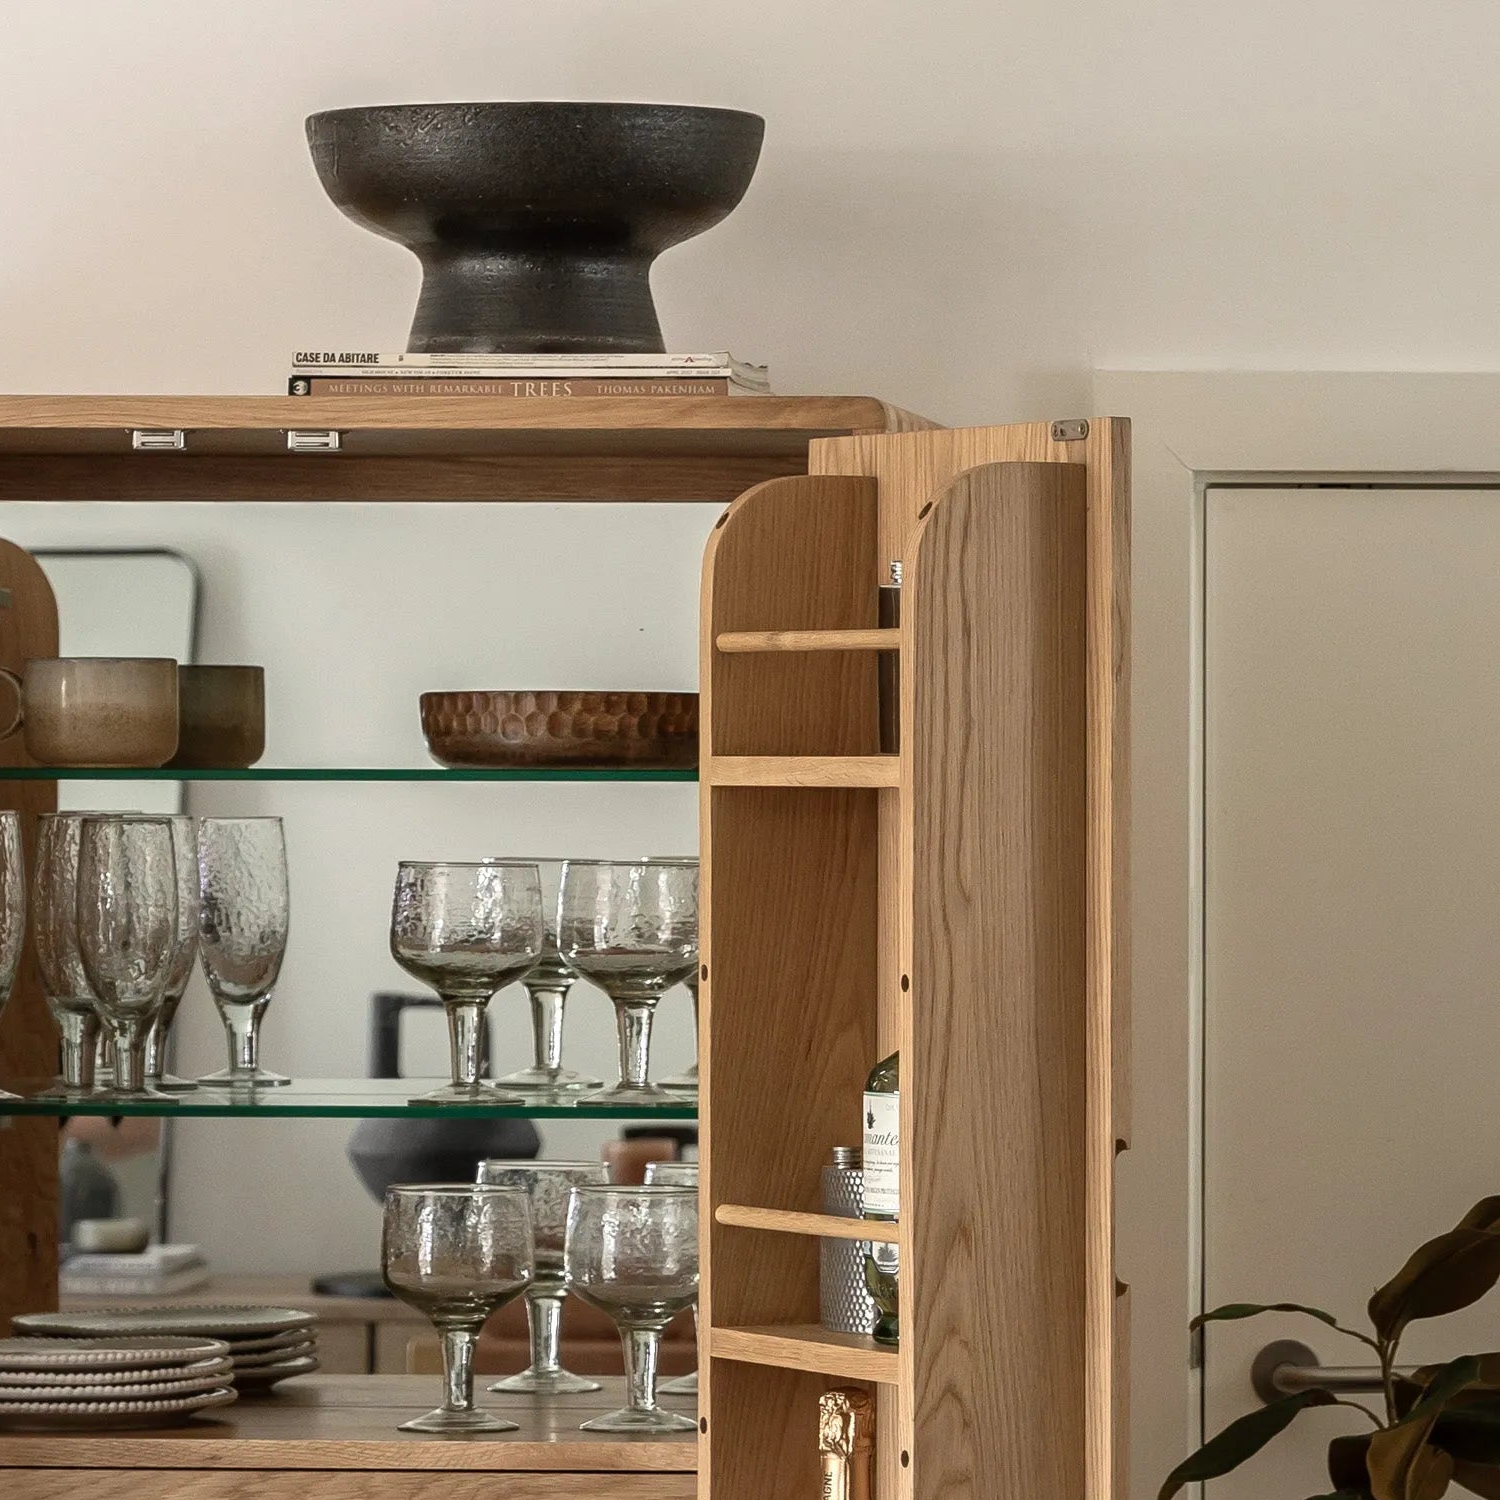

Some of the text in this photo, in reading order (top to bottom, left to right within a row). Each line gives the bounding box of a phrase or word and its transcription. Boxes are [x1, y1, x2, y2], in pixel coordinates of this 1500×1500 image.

[295, 352, 380, 364] CASE DA ABITARE
[329, 383, 388, 393] MEETINGS
[392, 383, 425, 393] WITH
[510, 382, 573, 397] TREES
[597, 384, 646, 394] THOMAS
[651, 384, 715, 395] PAKENHAM
